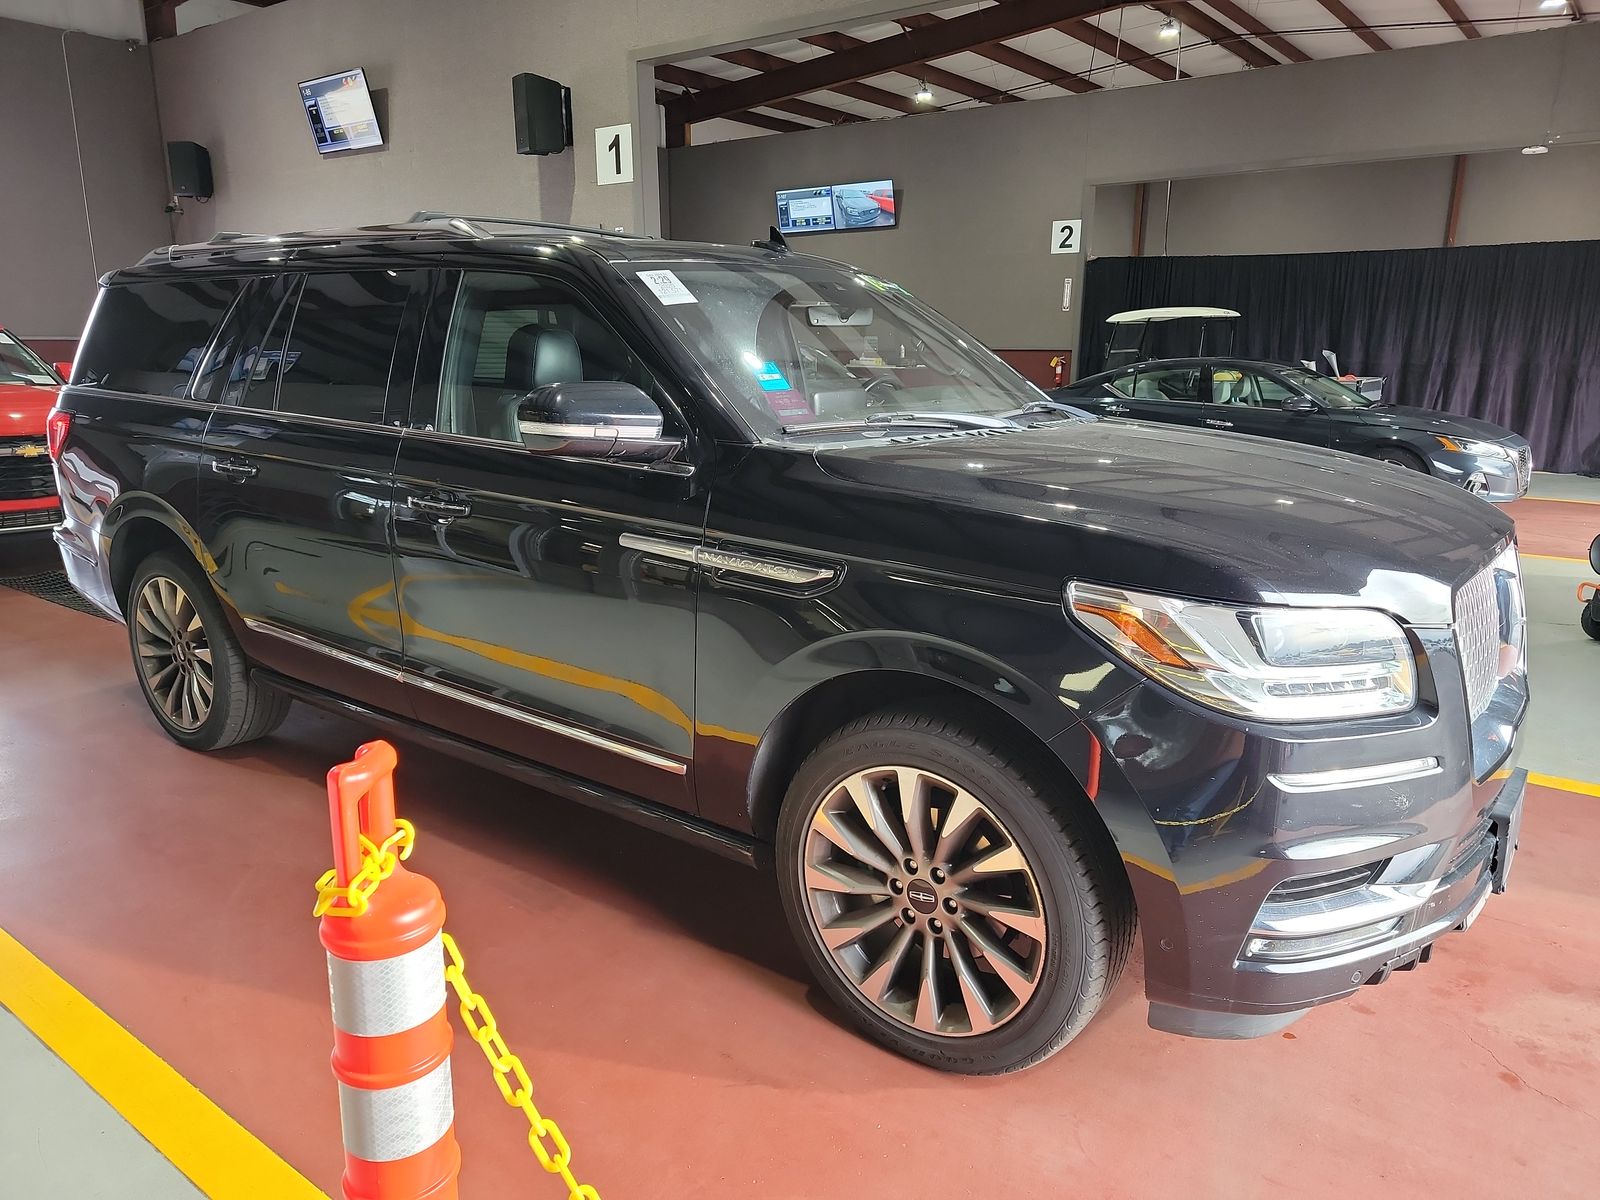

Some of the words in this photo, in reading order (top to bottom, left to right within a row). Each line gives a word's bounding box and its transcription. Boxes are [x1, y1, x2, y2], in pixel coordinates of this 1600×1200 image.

[608, 133, 622, 175] 1
[1058, 225, 1074, 249] 2
[703, 551, 801, 577] NAVIGATOR
